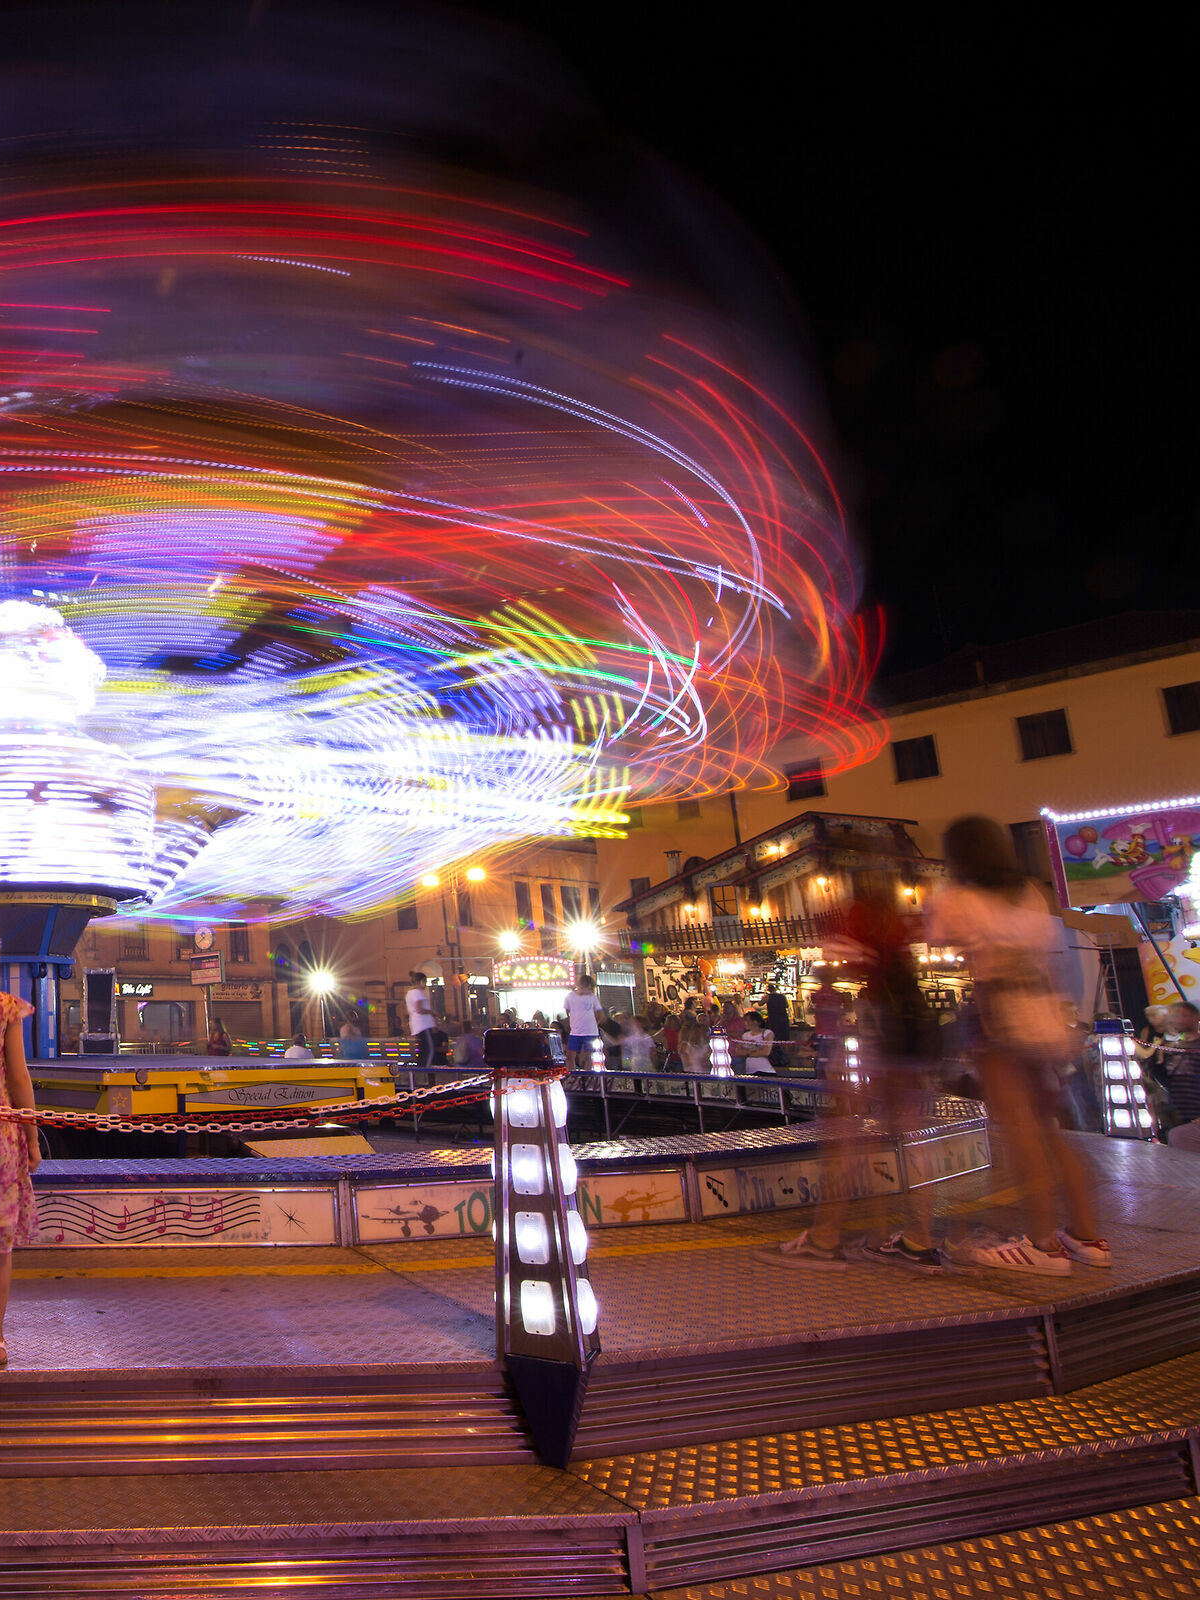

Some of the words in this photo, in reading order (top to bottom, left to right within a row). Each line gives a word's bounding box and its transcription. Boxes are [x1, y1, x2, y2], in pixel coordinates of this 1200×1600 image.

[499, 963, 568, 981] CASSA
[228, 1087, 272, 1105] Special
[274, 1086, 316, 1100] Edition
